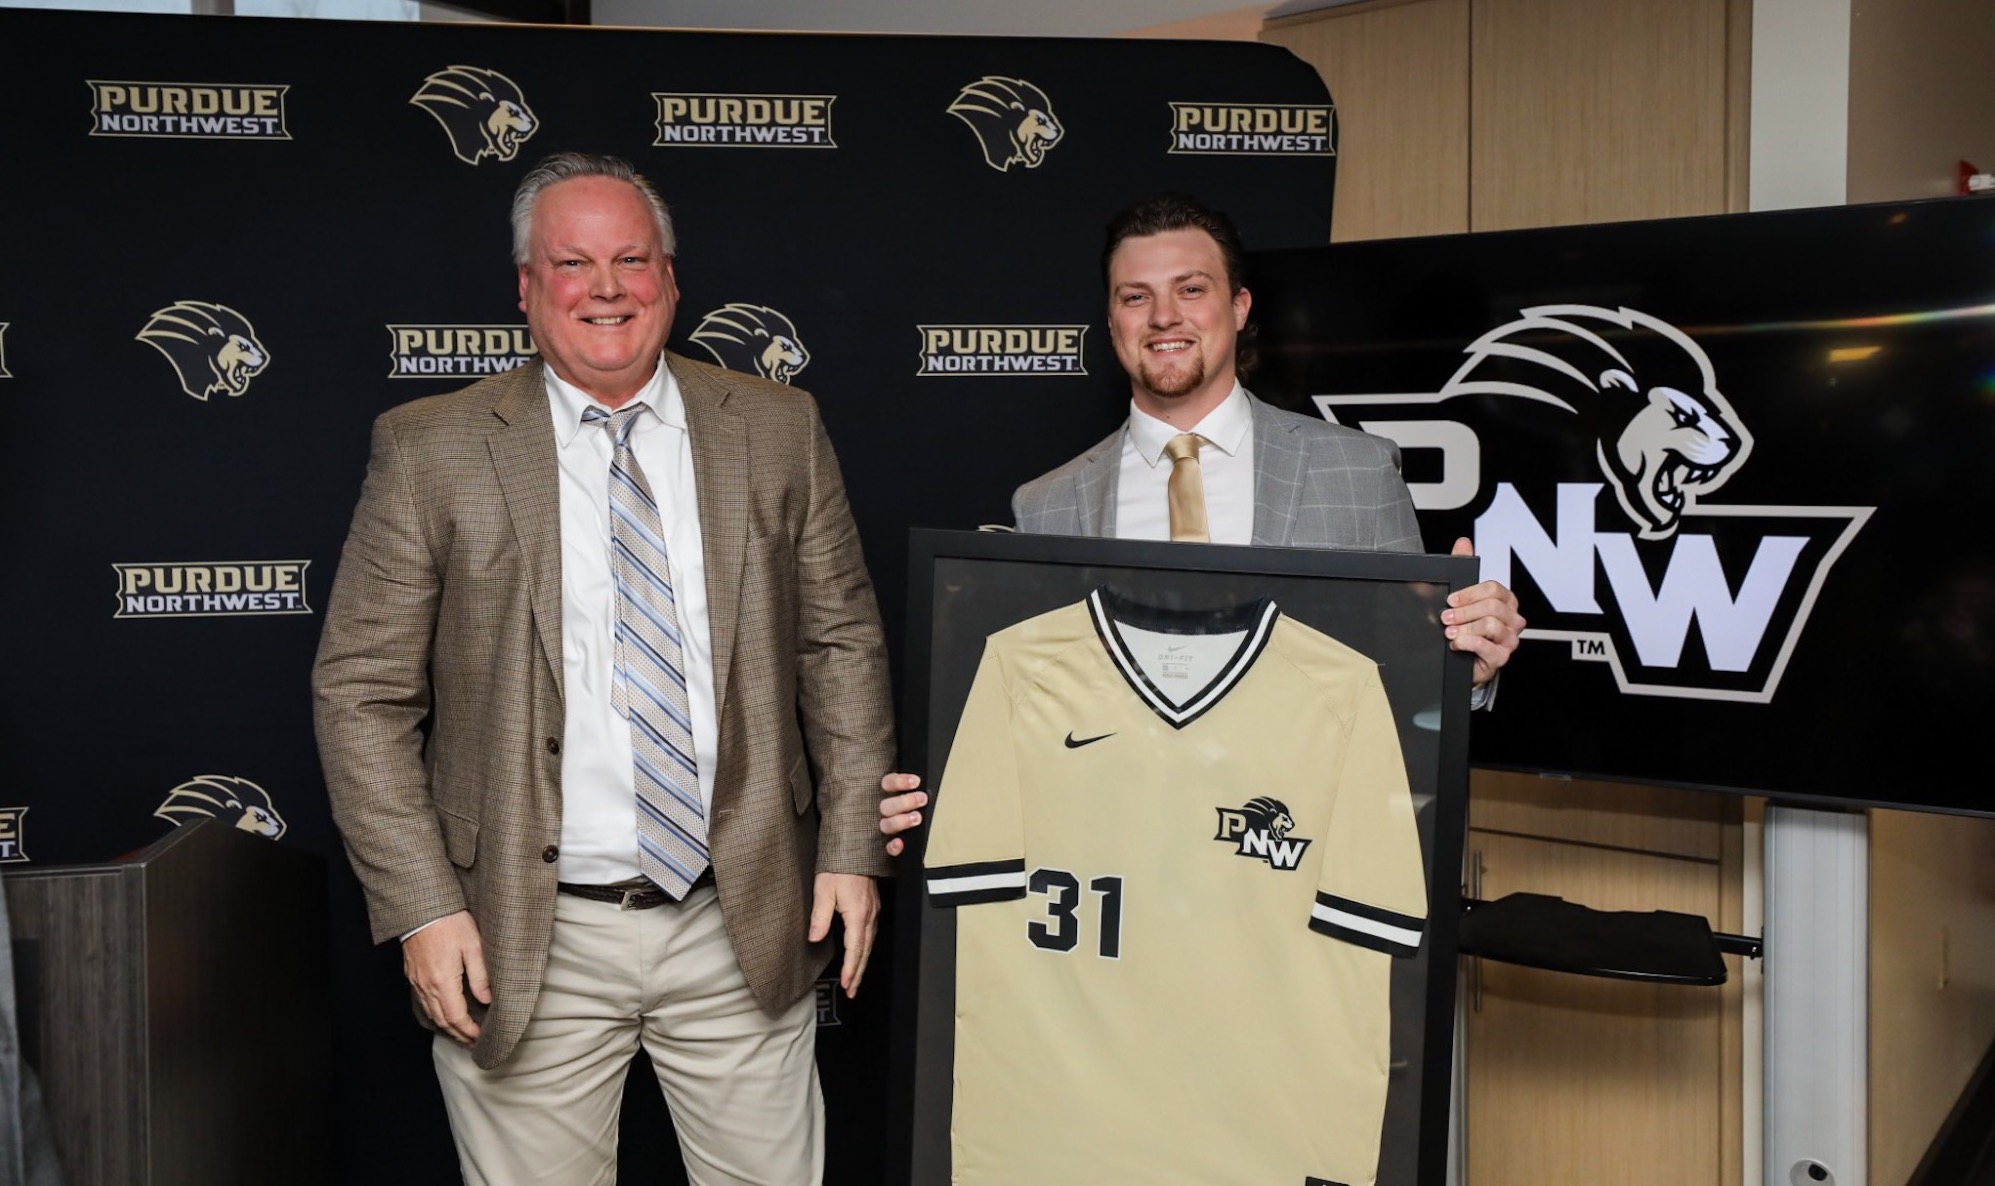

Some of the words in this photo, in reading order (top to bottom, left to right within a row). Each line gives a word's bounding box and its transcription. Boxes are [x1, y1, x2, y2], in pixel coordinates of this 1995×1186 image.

[98, 85, 279, 116] PURDUE
[662, 98, 825, 125] PURDUE
[101, 114, 279, 135] NORTHWEST
[1178, 107, 1328, 133] PURDUE
[663, 125, 826, 144] NORTHWEST
[1178, 133, 1327, 151] NORTHWEST
[397, 329, 539, 356] PURDU
[927, 329, 1078, 354] PURDUE
[927, 355, 1078, 372] NORTHWEST
[124, 565, 299, 595] PURDUE
[126, 592, 300, 613] NORTHWEST
[1577, 639, 1605, 656] TM
[1220, 811, 1305, 868] PNW
[1026, 867, 1124, 960] 31
